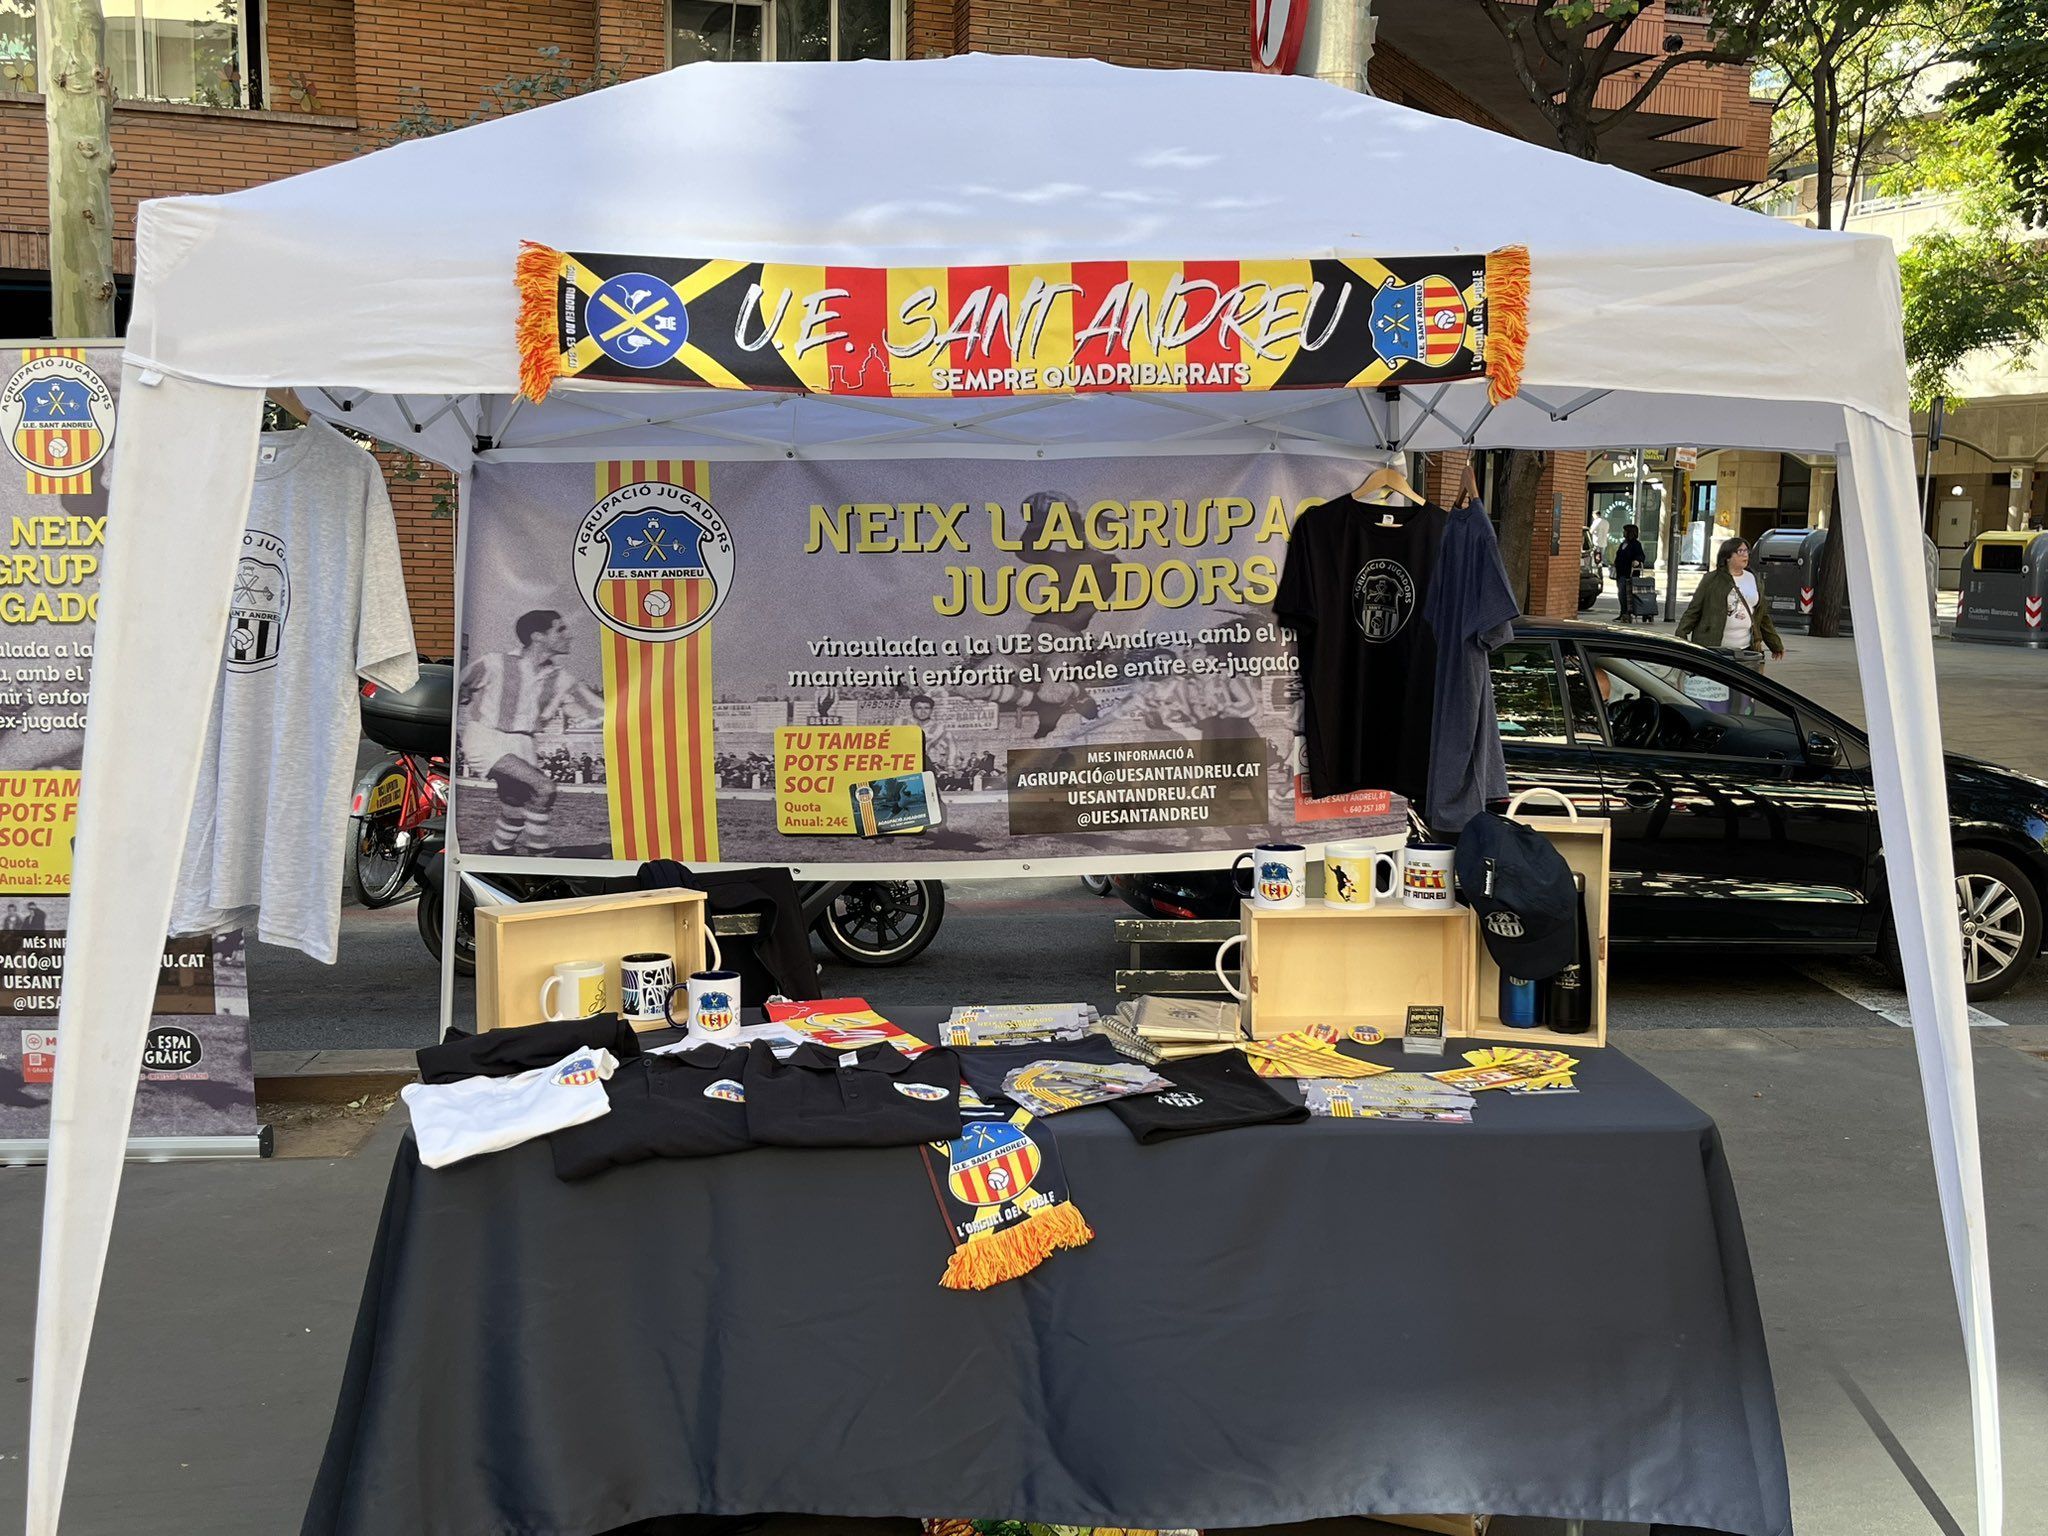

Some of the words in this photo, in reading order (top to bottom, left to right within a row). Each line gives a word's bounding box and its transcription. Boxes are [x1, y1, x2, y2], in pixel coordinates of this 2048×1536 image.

[734, 283, 855, 361] U.E.
[882, 277, 1085, 366] SANT
[1069, 272, 1352, 364] ANDREU
[2, 359, 55, 413] AGRUPACIÓ
[58, 359, 113, 411] JUGADORS
[931, 367, 1038, 392] SEMPRE
[1042, 362, 1252, 389] QUADRIBARRATS
[577, 483, 651, 557] AGRUPACIÓ
[656, 486, 731, 554] JUGADORS
[804, 502, 970, 553] NEIX
[10, 516, 108, 548] NEIX
[607, 569, 628, 578] U.E.
[630, 569, 659, 578] SANT
[661, 569, 705, 578] ANDREU
[932, 555, 1279, 616] JUGADORS
[1388, 563, 1412, 604] JUGADORS
[807, 635, 937, 657] vinculada
[941, 639, 961, 657] a
[964, 634, 991, 655] la
[995, 633, 1032, 655] UE
[1037, 631, 1094, 653] Sant
[1097, 628, 1194, 651] Andreu,
[1197, 623, 1251, 645] amb
[1255, 623, 1277, 643] el
[55, 644, 69, 659] a
[73, 641, 94, 659] la
[16, 665, 60, 682] amb
[65, 665, 84, 682] el
[788, 664, 903, 687] mantenir
[908, 664, 919, 686] i
[922, 664, 1017, 686] enfortir
[1018, 663, 1042, 684] el
[1047, 660, 1119, 682] vincle
[1123, 655, 1186, 677] entre
[26, 688, 34, 705] i
[784, 732, 813, 750] TU
[817, 728, 891, 750] TAMBÉ
[784, 754, 839, 772] POTS
[843, 753, 916, 771] FER-TE
[1087, 752, 1112, 764] MES
[1114, 747, 1184, 762] INFORMACIÓ
[1186, 748, 1195, 759] A
[784, 776, 835, 794] SOCI
[1017, 763, 1261, 788] AGRUPACIÓ@UESANTANDREU.CAT
[0, 778, 27, 798] TU
[1068, 785, 1217, 805] UESANTANDREU.CAT
[1331, 794, 1350, 803] SANT
[1350, 792, 1378, 802] ANDREU,
[1378, 791, 1387, 800] 87
[0, 803, 57, 822] POTS
[784, 801, 821, 813] Quota
[1077, 805, 1209, 827] @UESANTANDREU
[1349, 805, 1362, 814] 640
[1363, 804, 1374, 813] 257
[784, 816, 824, 827] Anual:
[826, 816, 848, 827] 24€
[0, 827, 53, 847] SOCI
[0, 856, 39, 869] Quota
[0, 873, 42, 885] Anual:
[45, 874, 71, 885] 24€
[23, 936, 46, 949] MÉS
[159, 953, 206, 969] U.CAT
[158, 1035, 191, 1049] ESPAI
[144, 1048, 192, 1064] GRÀFIC
[952, 1162, 970, 1172] U.E.
[971, 1154, 992, 1166] SANT
[994, 1138, 1028, 1157] ANDREU
[1004, 1205, 1022, 1221] DEL
